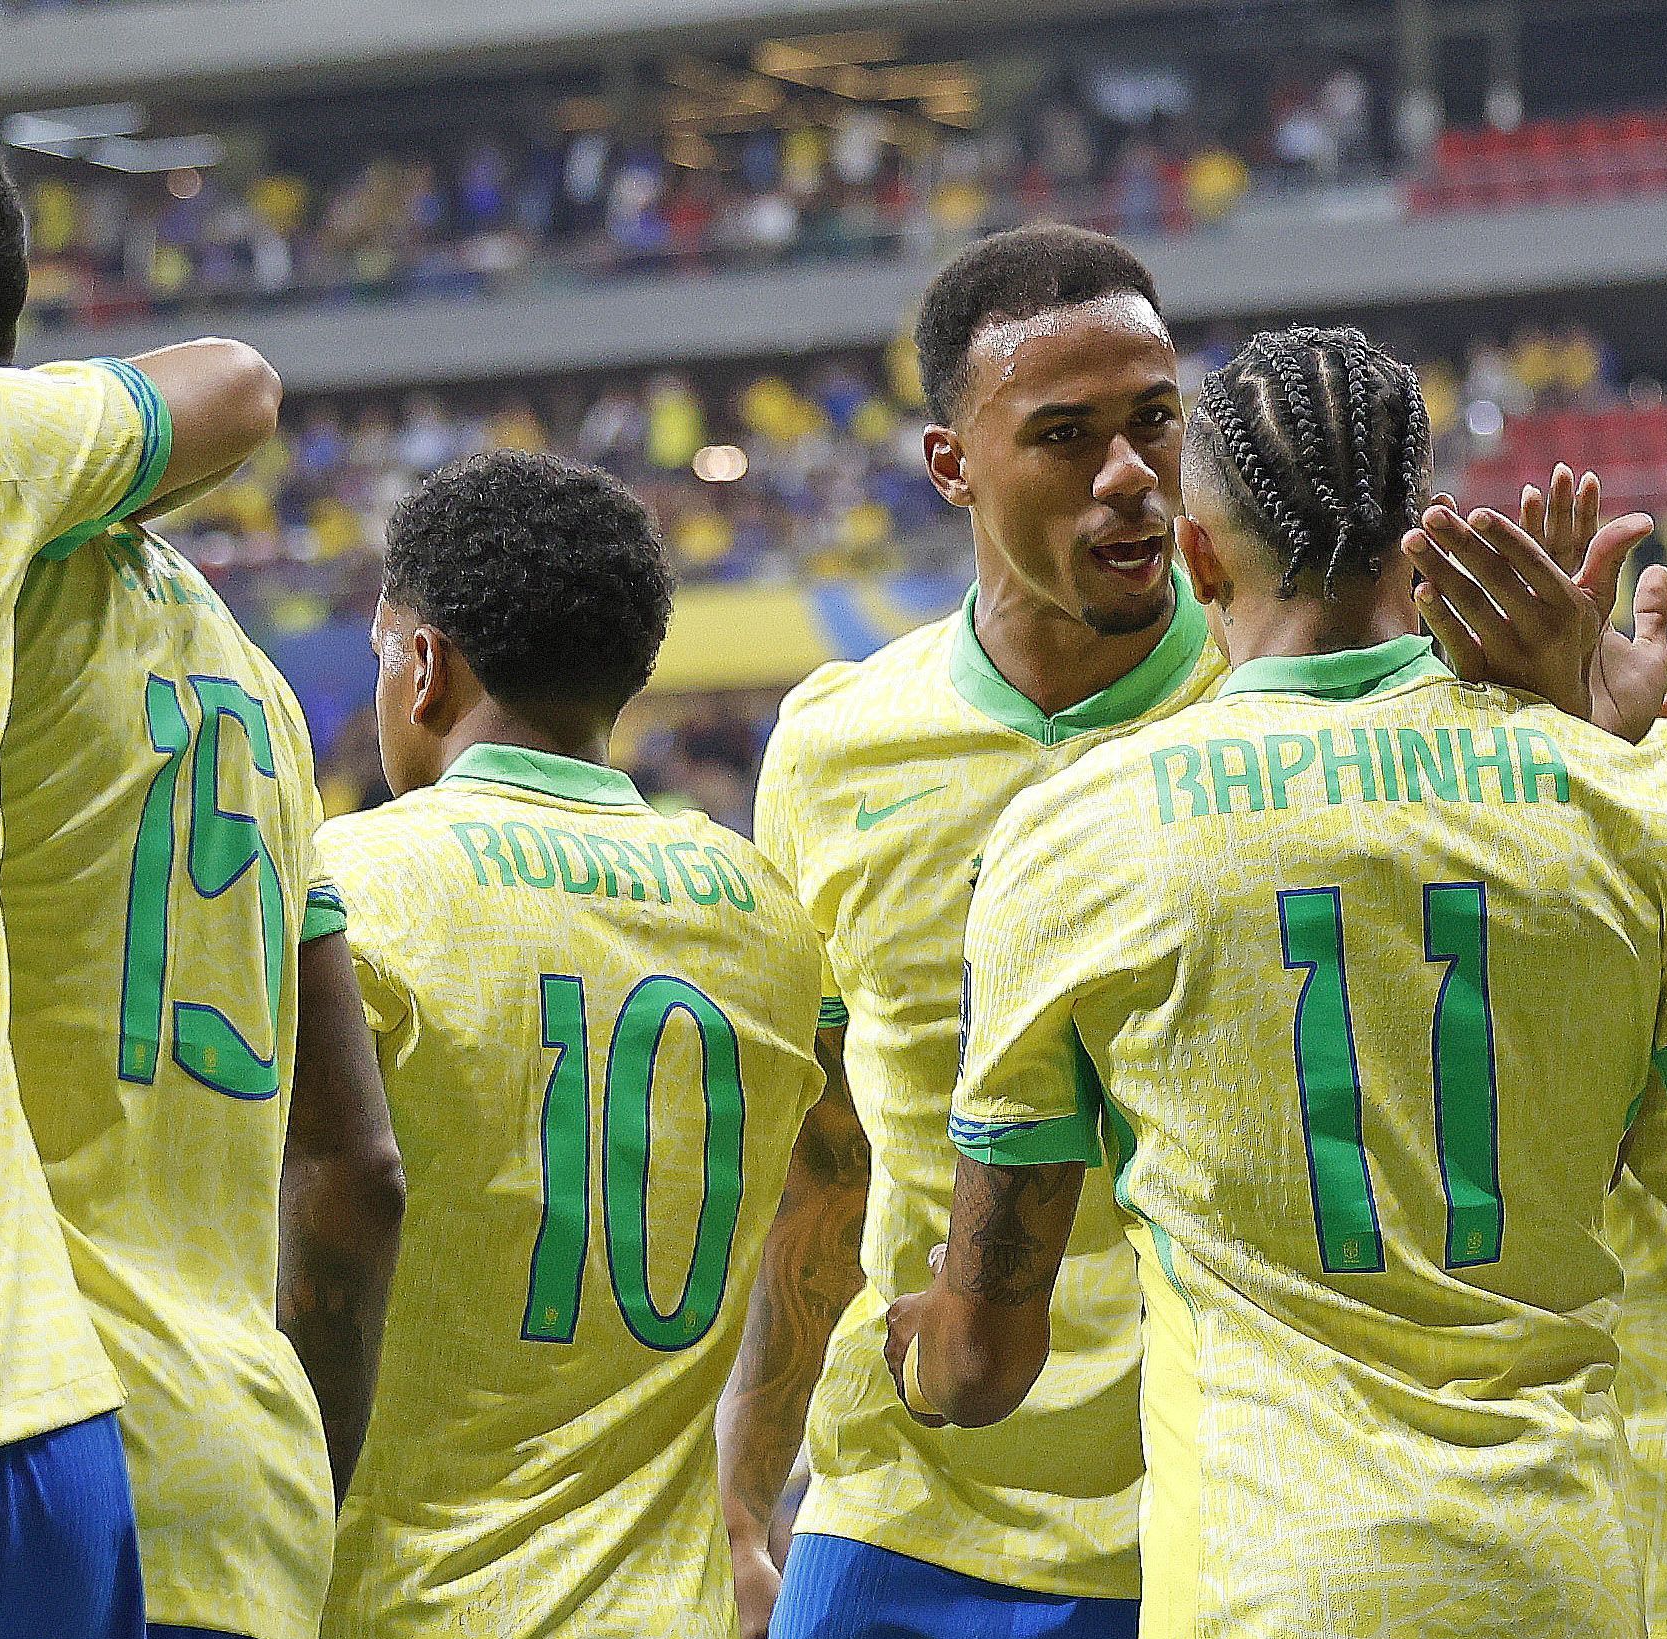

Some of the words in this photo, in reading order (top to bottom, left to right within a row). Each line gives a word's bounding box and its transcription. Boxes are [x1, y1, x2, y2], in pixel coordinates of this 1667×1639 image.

[118, 673, 284, 1101] 15
[450, 820, 756, 914] RODRYGO
[1151, 726, 1571, 826] RAPHINHA
[521, 973, 745, 1353] 10
[1277, 881, 1506, 1275] 11
